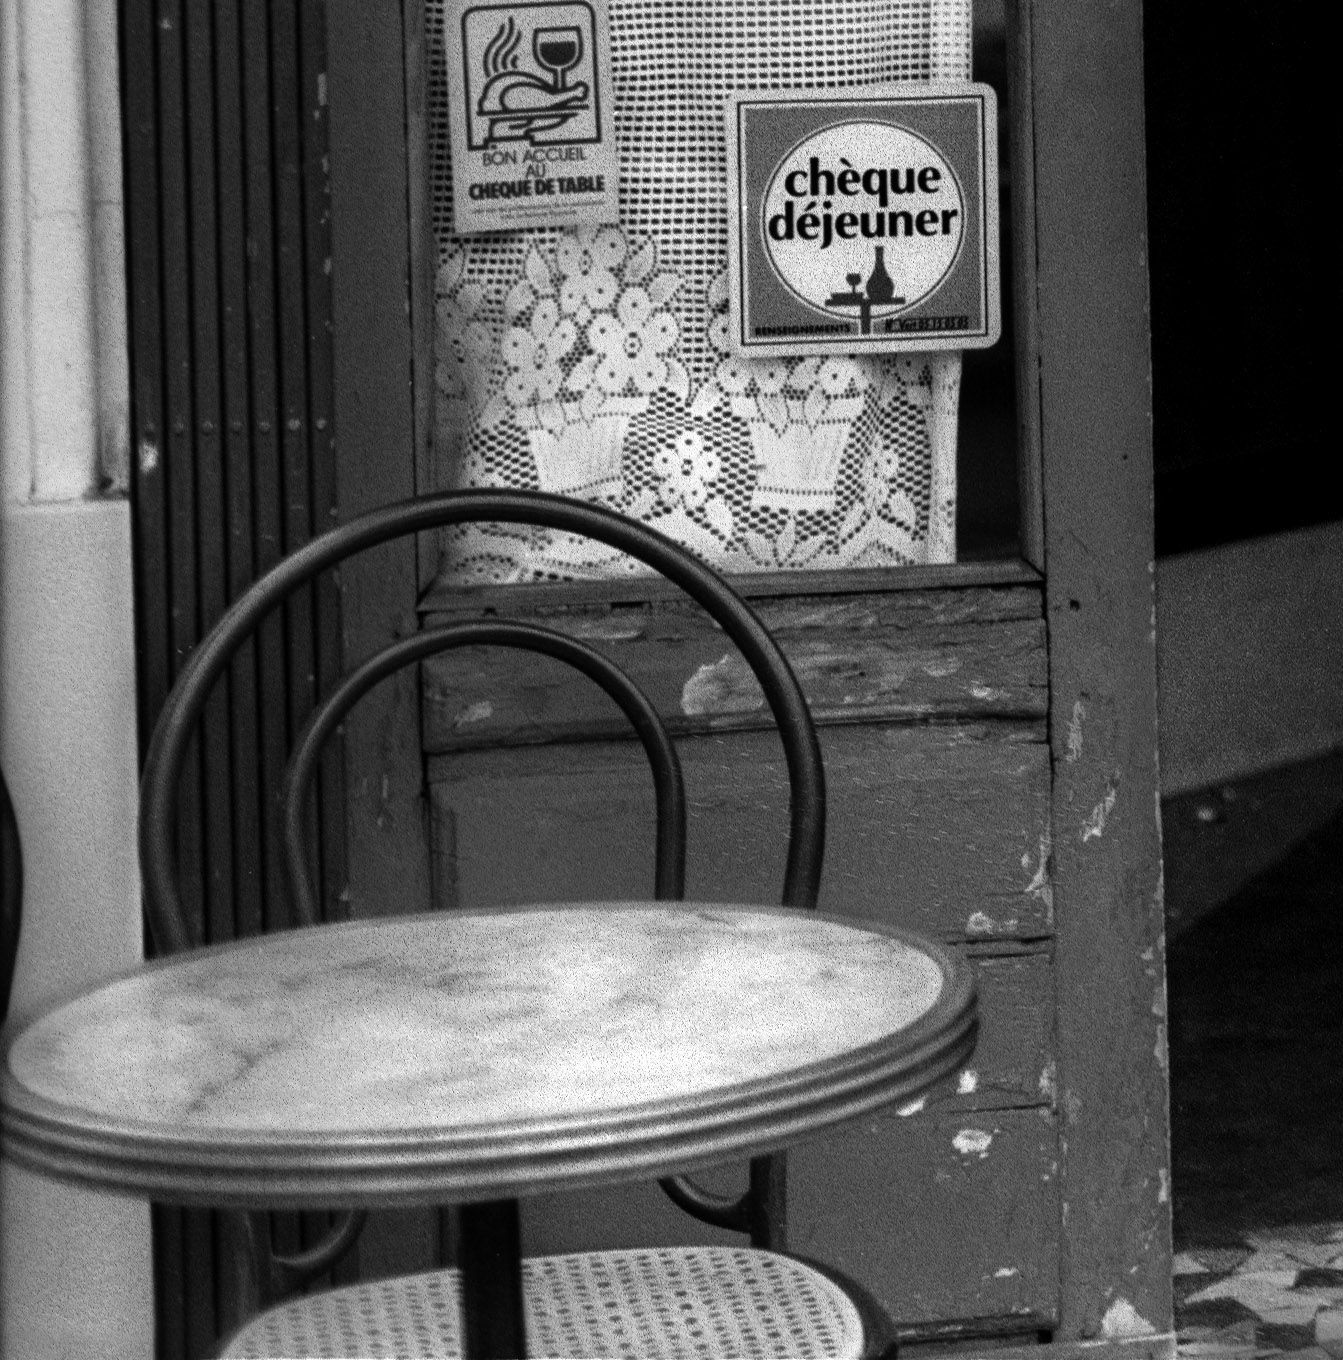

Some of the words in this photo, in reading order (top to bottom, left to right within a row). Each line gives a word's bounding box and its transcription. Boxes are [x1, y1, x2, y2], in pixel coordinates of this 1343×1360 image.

[482, 150, 517, 167] BON
[523, 147, 587, 163] ACCUEIL
[525, 163, 546, 178] AU
[784, 156, 942, 208] chèque
[468, 180, 533, 201] CHEQUE
[534, 178, 556, 195] DE
[557, 175, 605, 194] TABLE
[768, 200, 959, 249] déjeuner
[755, 323, 851, 337] RENSEIGNEMENTS
